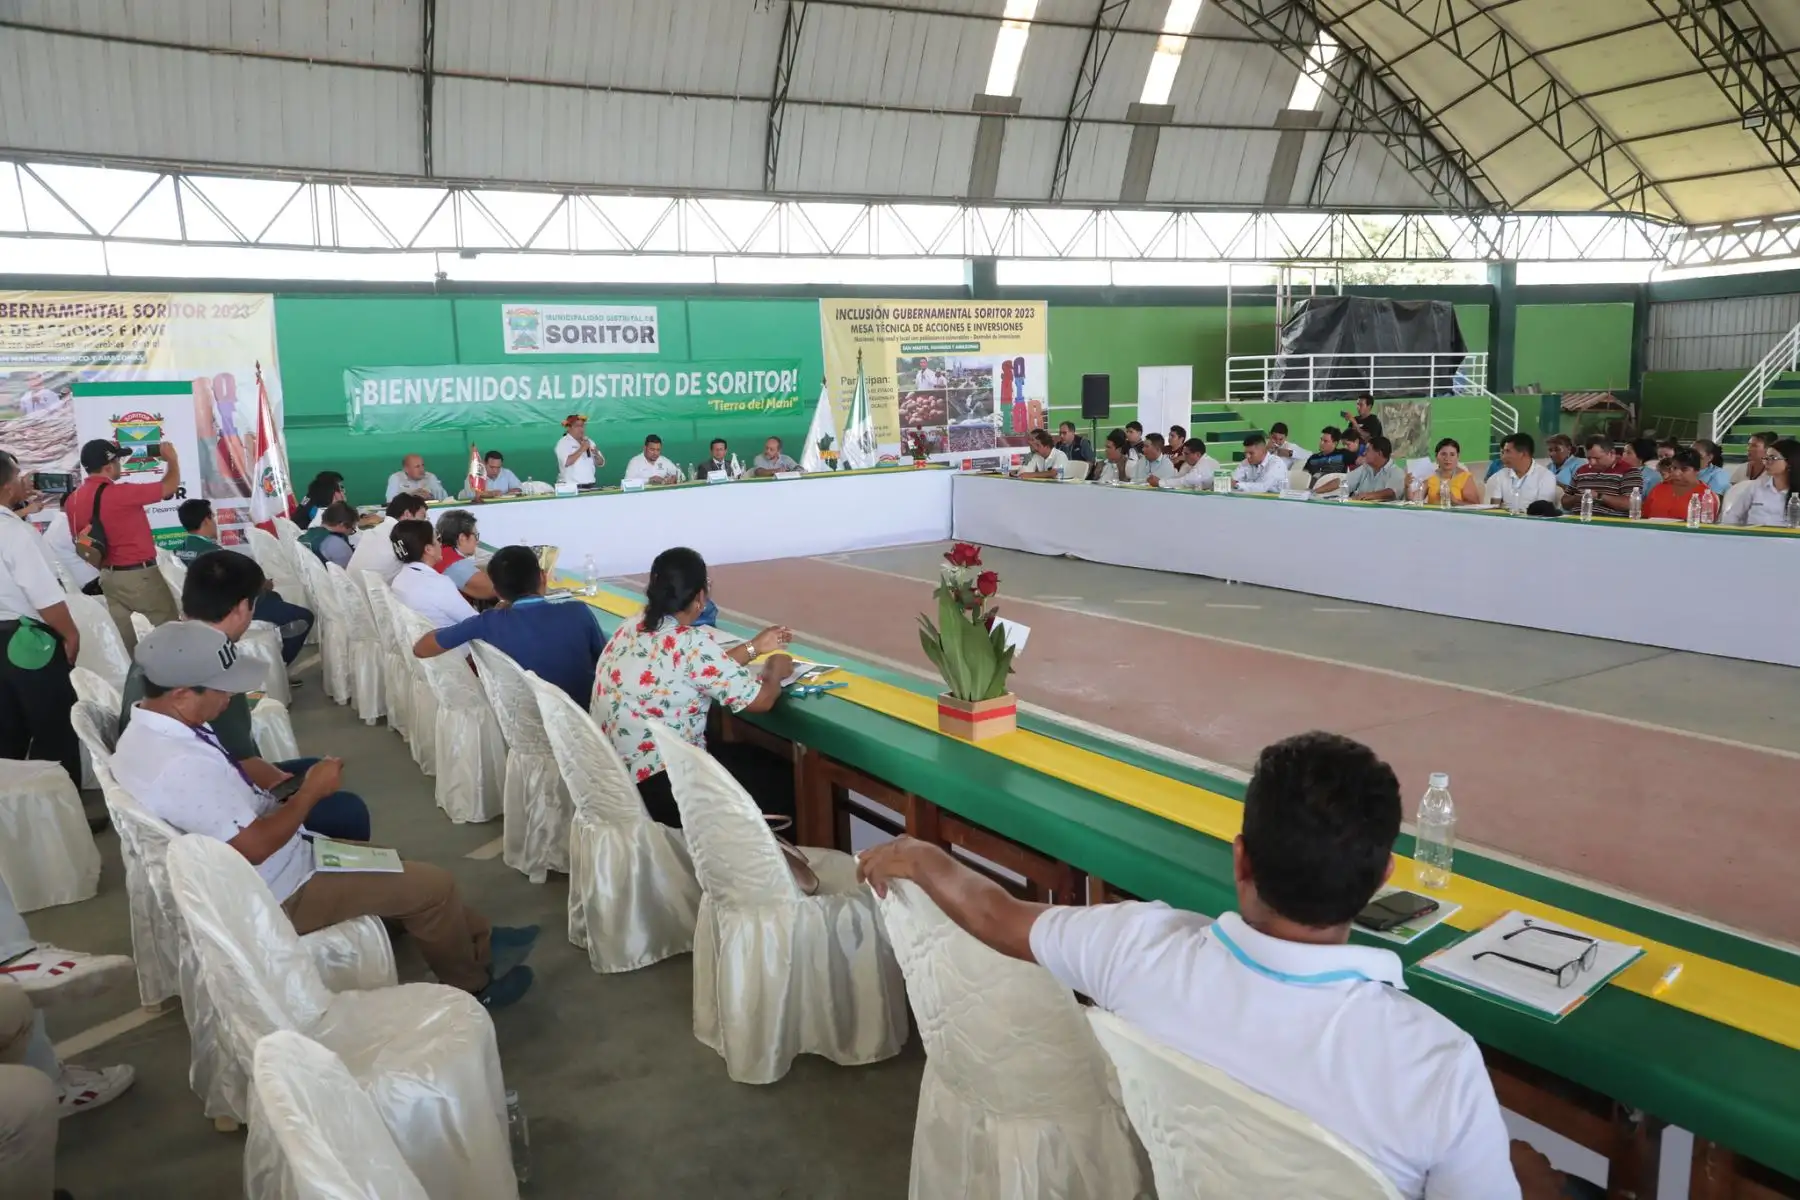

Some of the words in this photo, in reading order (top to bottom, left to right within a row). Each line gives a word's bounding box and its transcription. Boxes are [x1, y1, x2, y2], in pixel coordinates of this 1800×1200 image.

[133, 303, 206, 319] SORITOR
[835, 306, 890, 321] INCLUSIÓN
[893, 307, 972, 320] GUBERNAMENTAL
[974, 307, 1012, 319] SORITOR
[1015, 307, 1035, 318] 2023
[545, 324, 655, 344] SORITOR
[851, 323, 873, 334] MESA
[876, 321, 911, 333] TÉCNICA
[912, 323, 924, 333] DE
[925, 322, 965, 332] ACCIONES
[967, 322, 972, 332] E
[973, 322, 1024, 332] INVERSIONES
[840, 375, 891, 387] Parcipan:
[354, 375, 531, 415] ¡BIENVENIDOS
[537, 374, 565, 400] AL
[571, 371, 670, 399] DISTRITO
[675, 370, 701, 397] DE
[706, 368, 798, 394] SORITOR!
[748, 398, 764, 410] del
